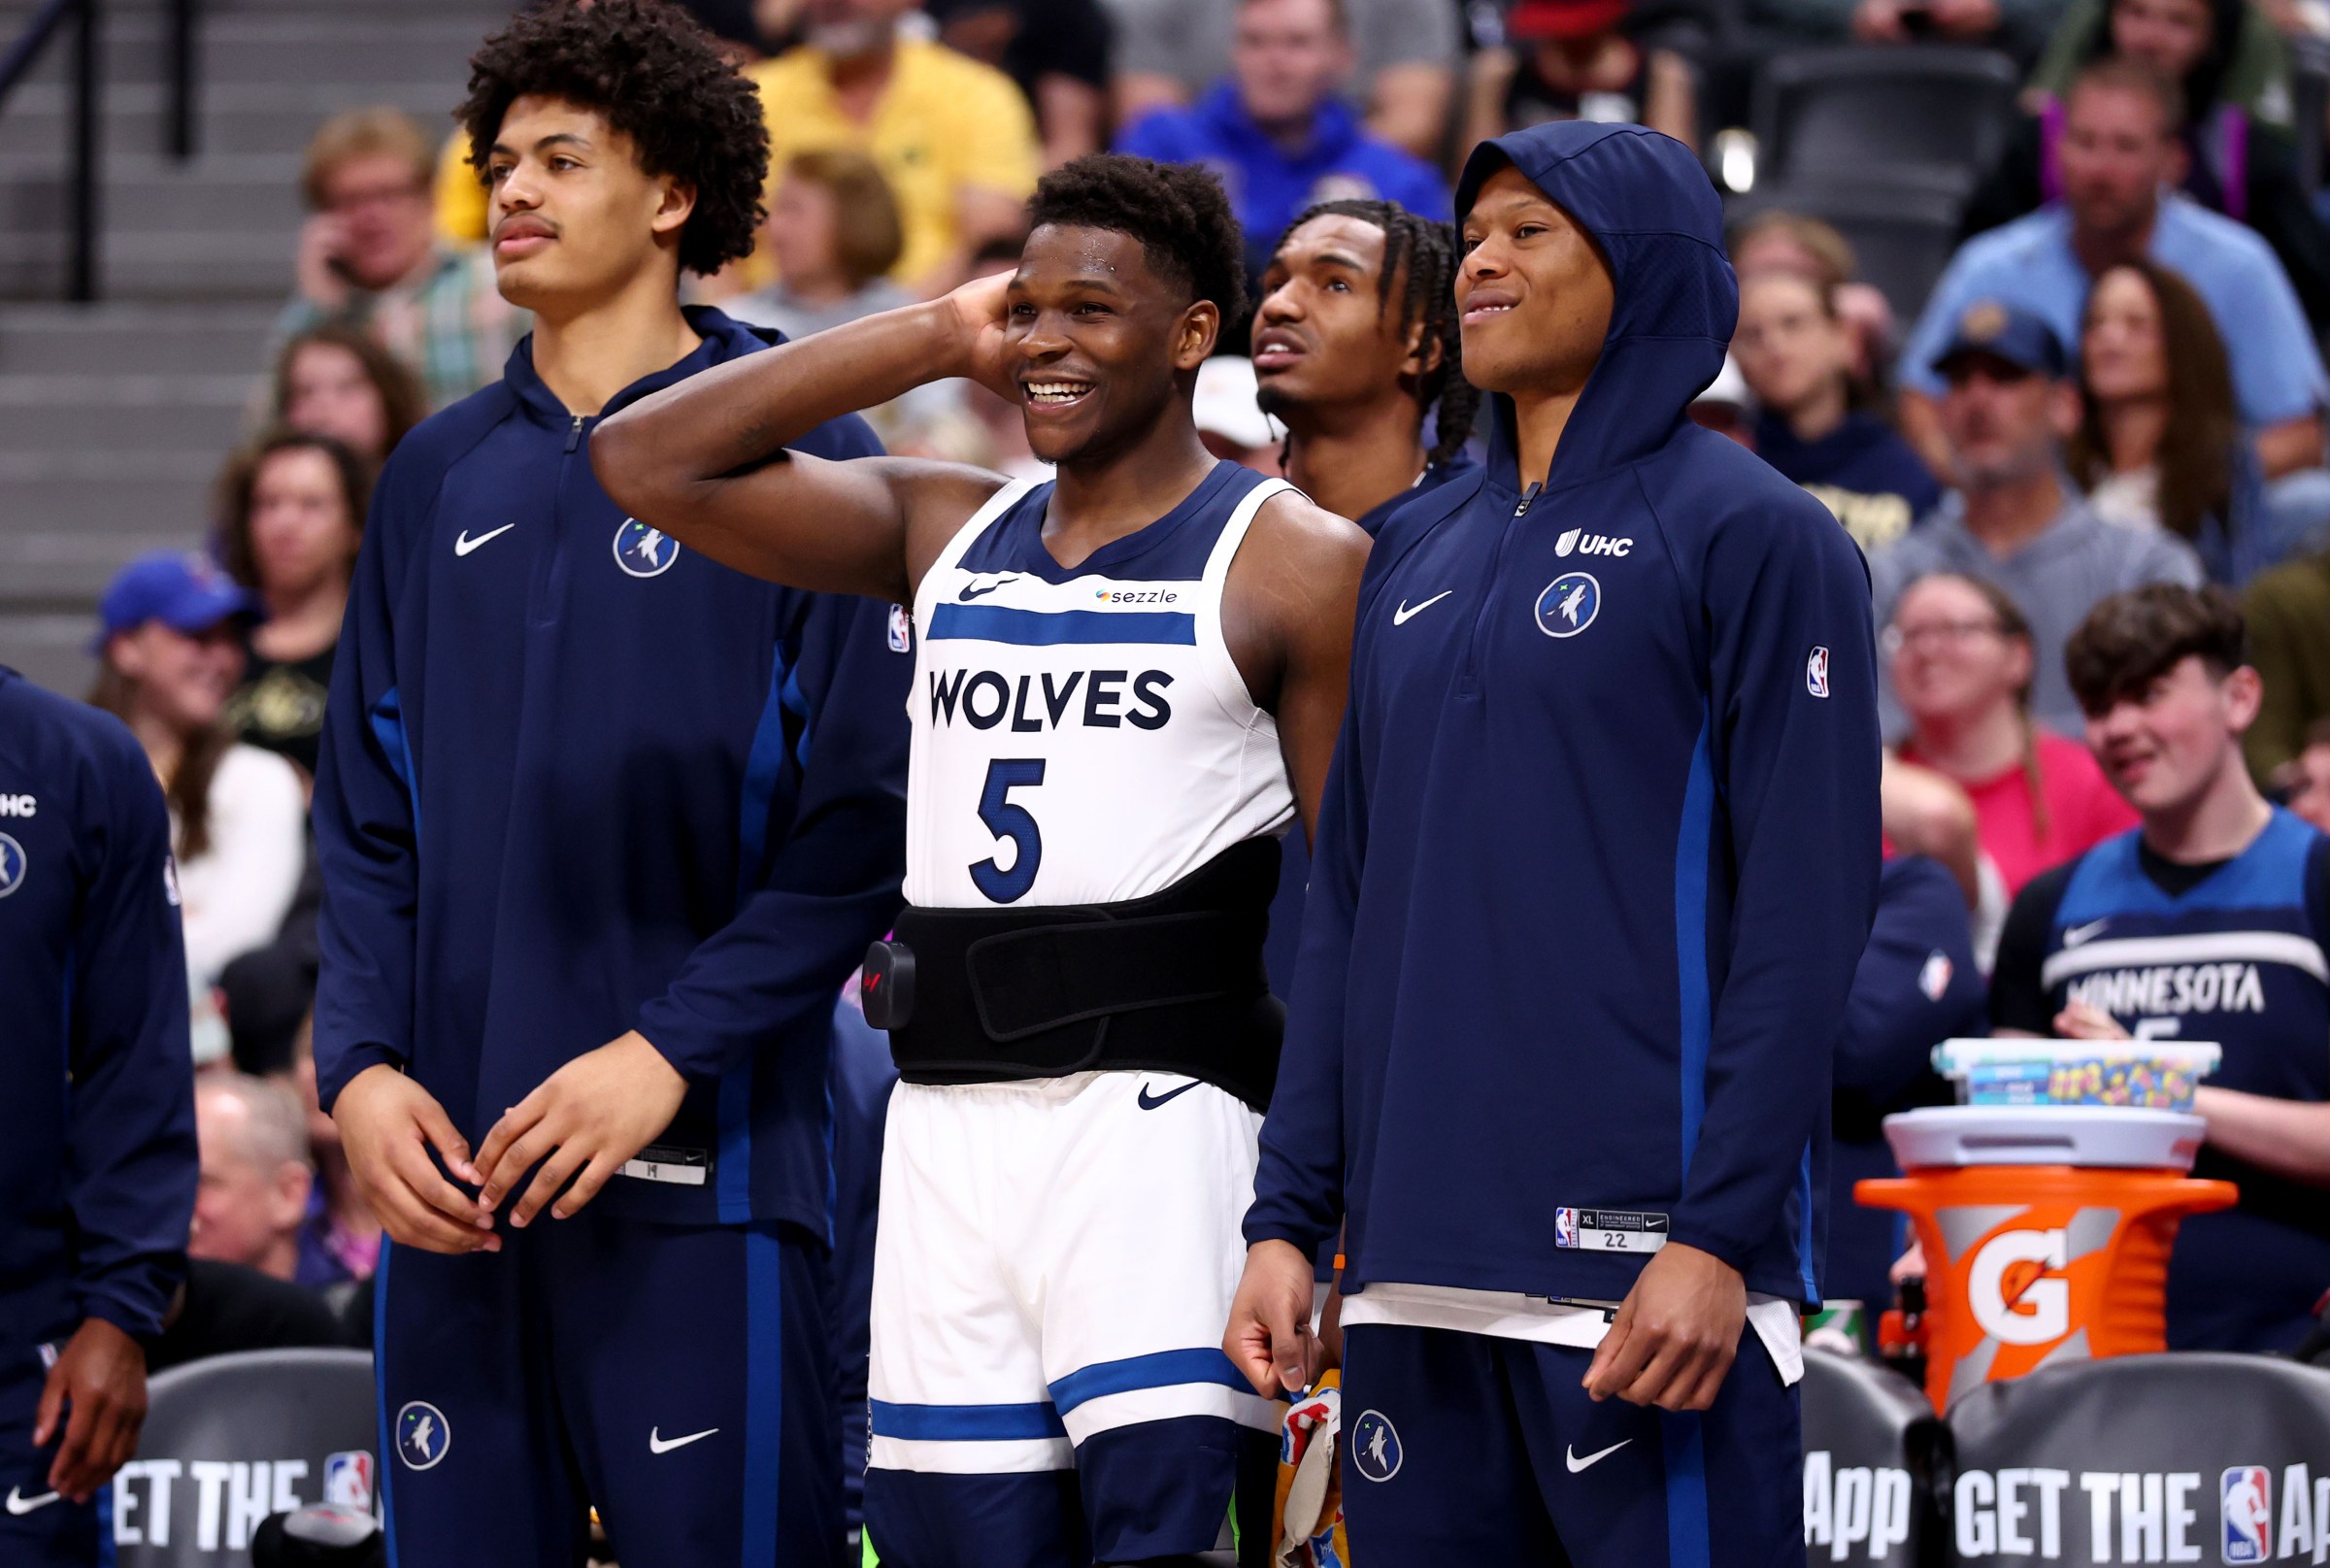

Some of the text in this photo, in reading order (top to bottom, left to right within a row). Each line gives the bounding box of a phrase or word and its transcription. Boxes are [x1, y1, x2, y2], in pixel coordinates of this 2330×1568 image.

[1579, 534, 1633, 557] UHC
[1111, 589, 1178, 604] sezzle
[930, 669, 1175, 732] WOLVES
[0, 793, 37, 818] HC
[968, 758, 1046, 904] 5
[1582, 1215, 1594, 1224] XL
[1604, 1232, 1628, 1249] 22
[1968, 1227, 2070, 1345] G
[113, 1459, 308, 1551] ET THE
[1803, 1451, 1913, 1562] App
[1954, 1467, 2071, 1559] GET
[2080, 1472, 2202, 1564] THE
